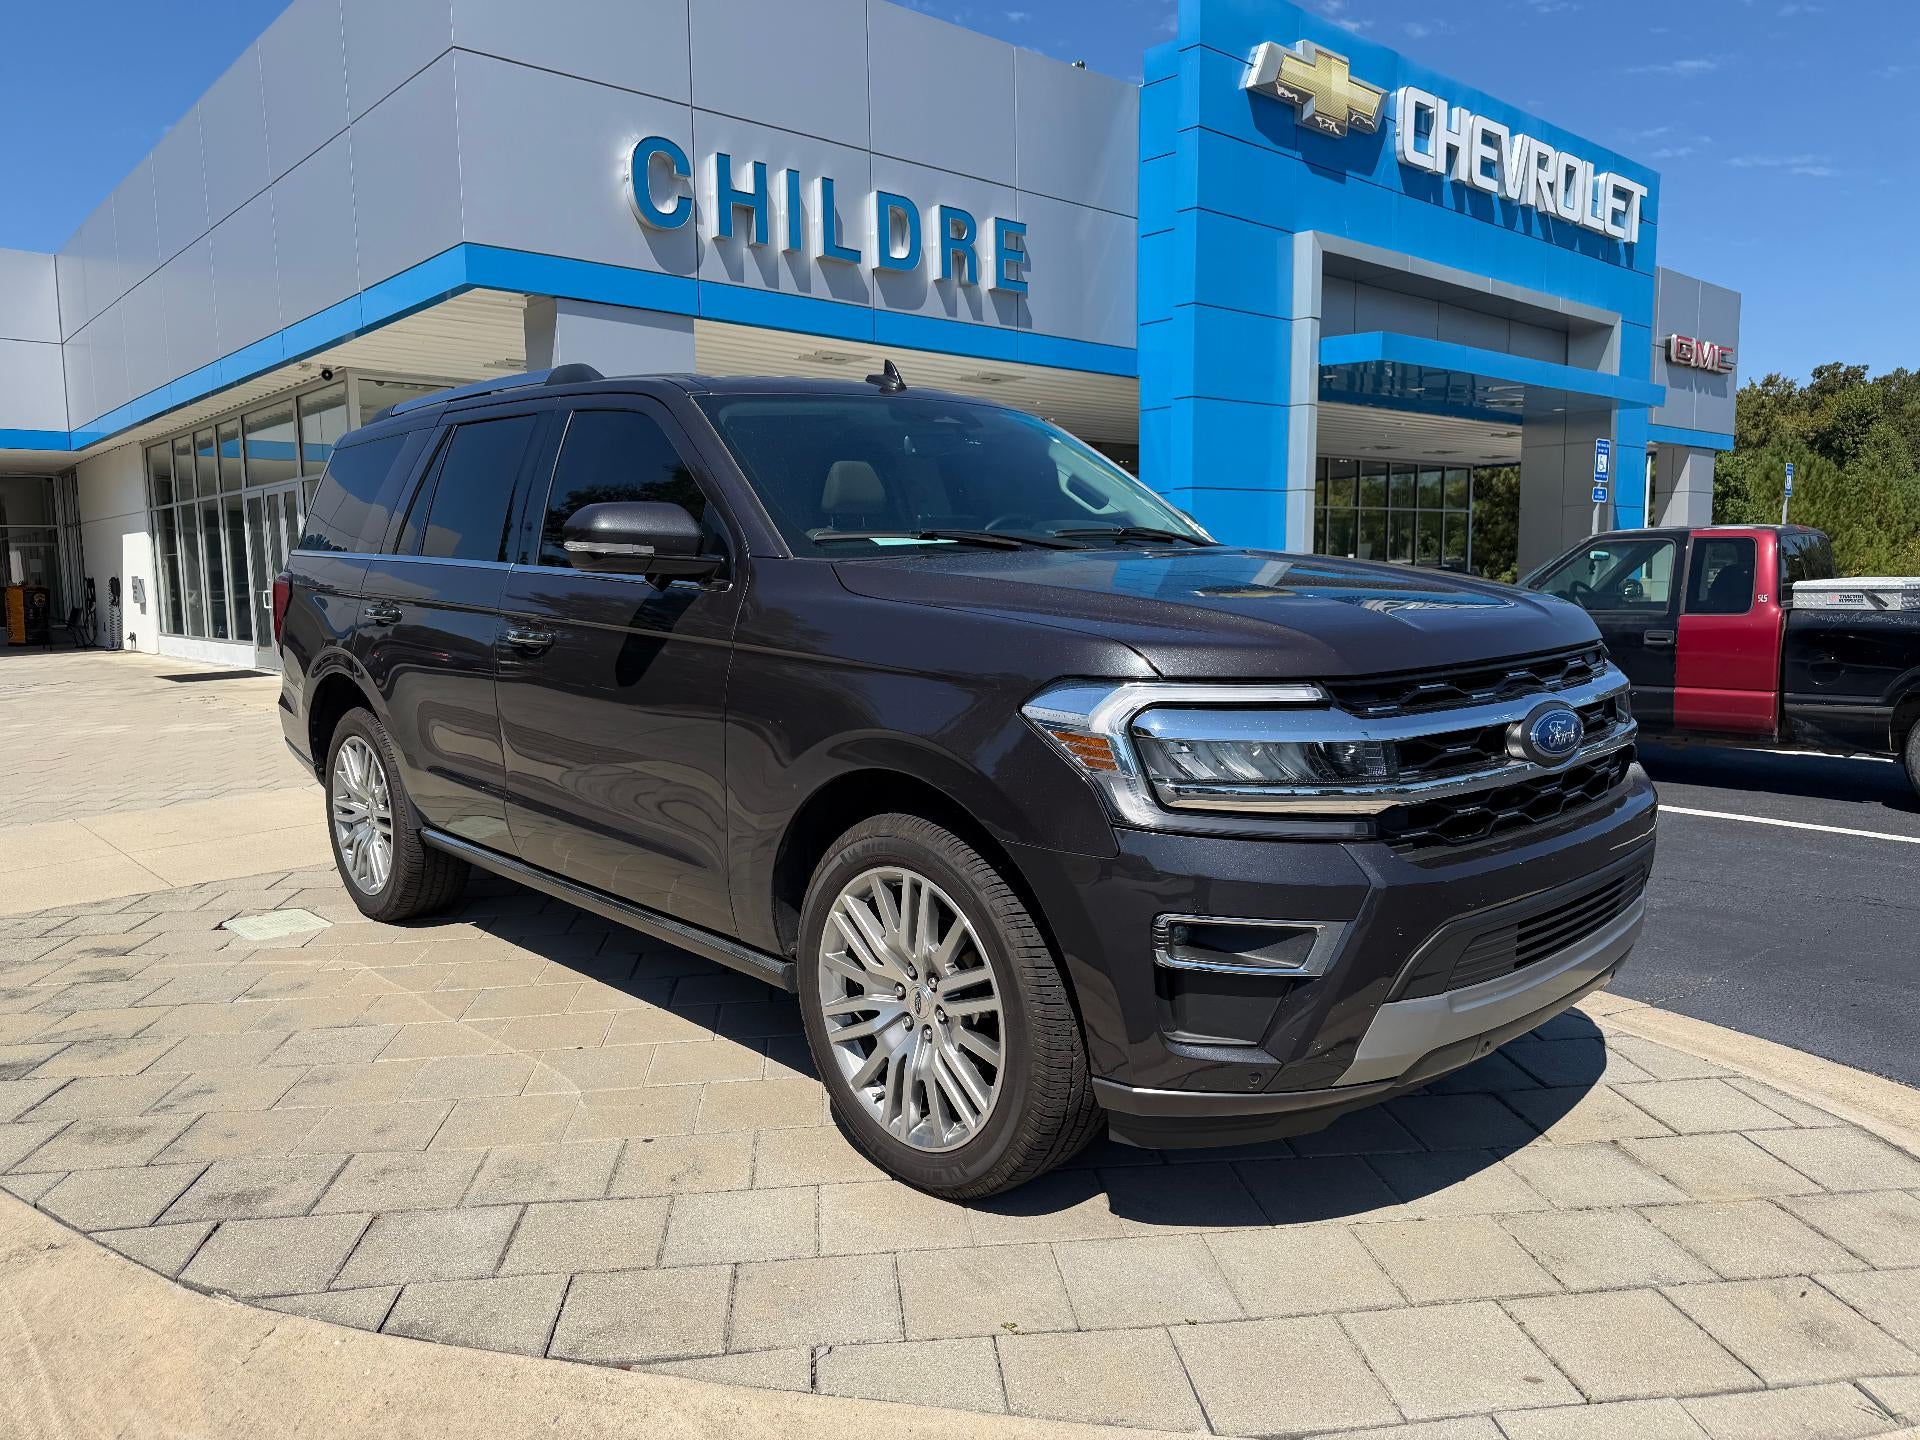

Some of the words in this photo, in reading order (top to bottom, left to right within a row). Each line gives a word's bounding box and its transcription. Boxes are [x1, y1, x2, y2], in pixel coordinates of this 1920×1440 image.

[1396, 86, 1648, 243] CHEVROLET
[627, 136, 1028, 297] CHILDRE
[1671, 334, 1734, 374] GMC
[1757, 594, 1768, 603] SLS
[1548, 719, 1576, 748] Ford
